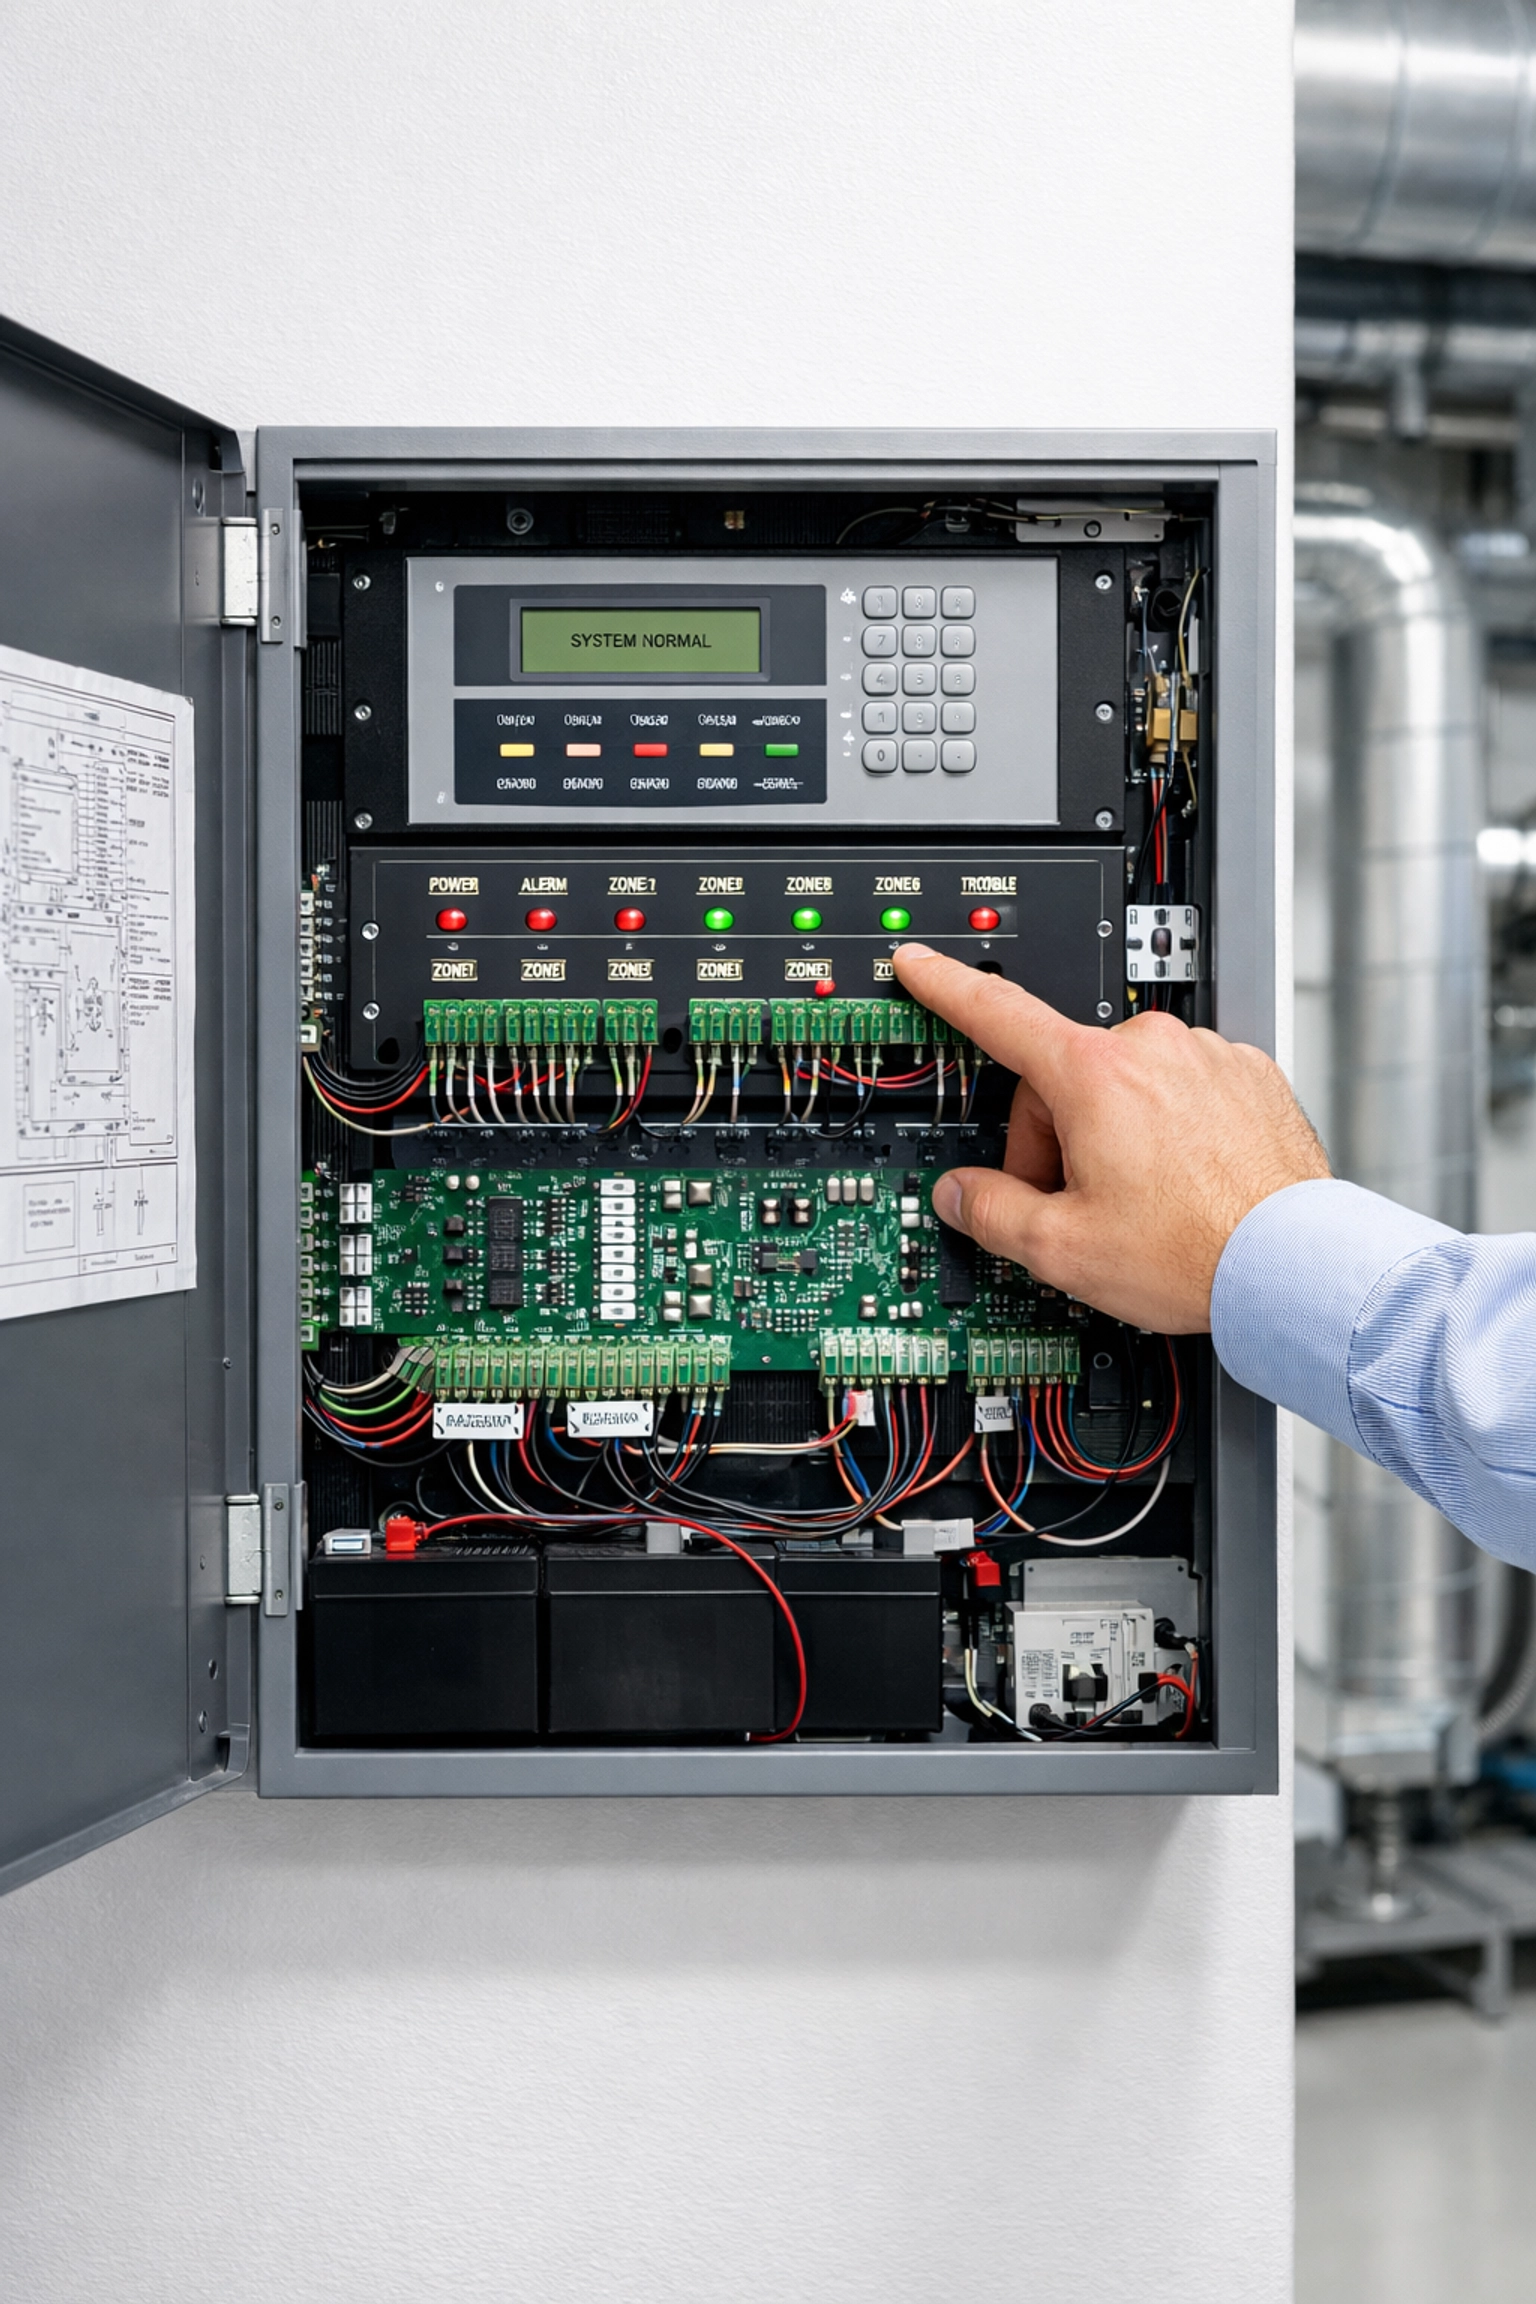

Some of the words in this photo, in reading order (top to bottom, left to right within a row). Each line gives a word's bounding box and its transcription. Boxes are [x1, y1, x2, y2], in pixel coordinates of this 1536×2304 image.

[571, 633, 637, 648] SYSTEM
[642, 633, 712, 648] NORMAL
[874, 876, 921, 892] ZONE6
